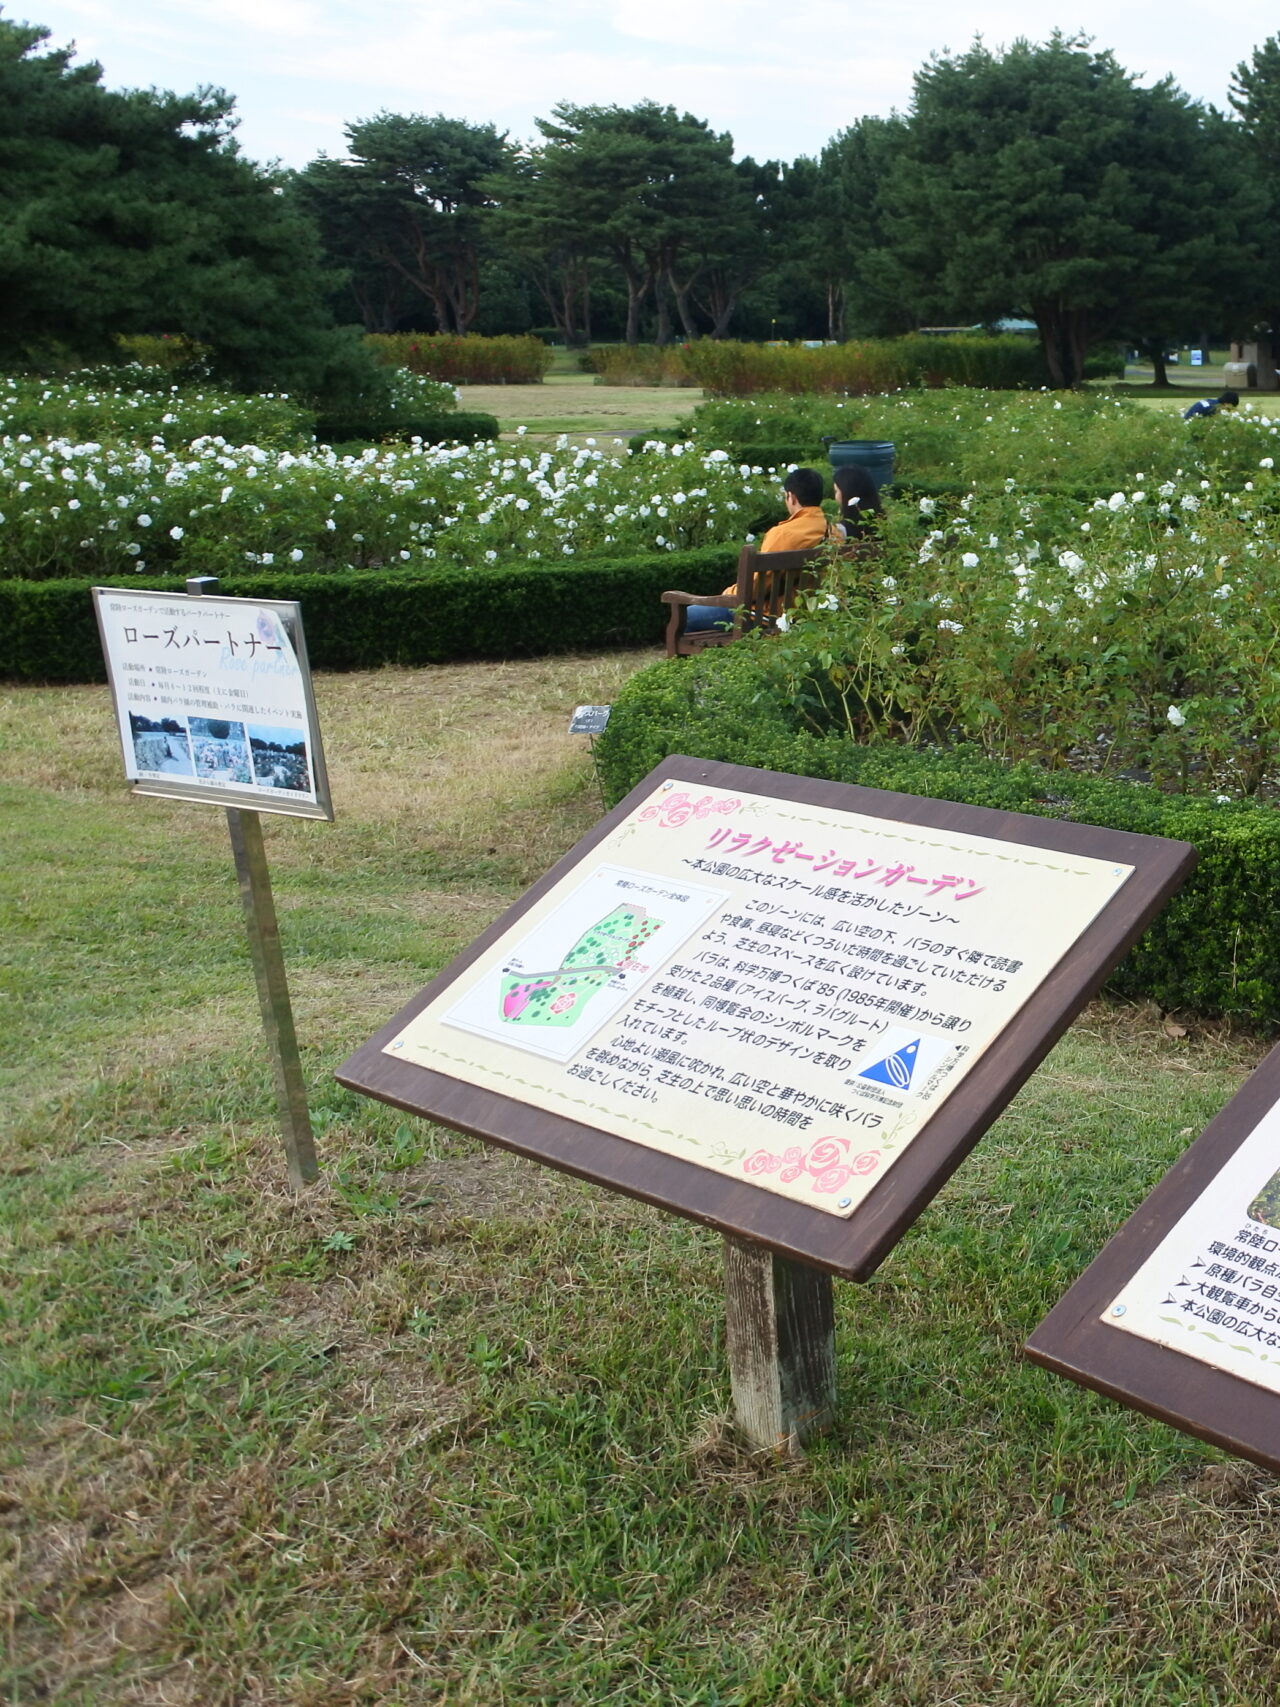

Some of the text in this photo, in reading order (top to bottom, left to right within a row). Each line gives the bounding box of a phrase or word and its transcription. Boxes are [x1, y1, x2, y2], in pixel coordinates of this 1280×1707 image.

[123, 625, 282, 658] ローズパートナー
[704, 826, 986, 901] リラクゼーションガーデン
[701, 930, 927, 997] よう、芝生のスペースを広く設けています。
[720, 913, 1008, 992] や食事、昼寝などくつろいだ時間を過ごしていただける
[745, 899, 1024, 974] このゾーンには、広い空の下、バラのすぐ隣で読書
[616, 1014, 688, 1045] 入れています。
[633, 998, 852, 1071] モチーフとしたループ状のデザインを取り
[651, 982, 868, 1052] を植栽し、同博覧会のシンボルマークを
[566, 1063, 658, 1102] お過ごしください。
[585, 1047, 814, 1130] を眺めながら、芝生の上で思い思いの時間を
[611, 1034, 884, 1129] 心地よい潮風に吹かれ、広い空と華やかに咲くバラ
